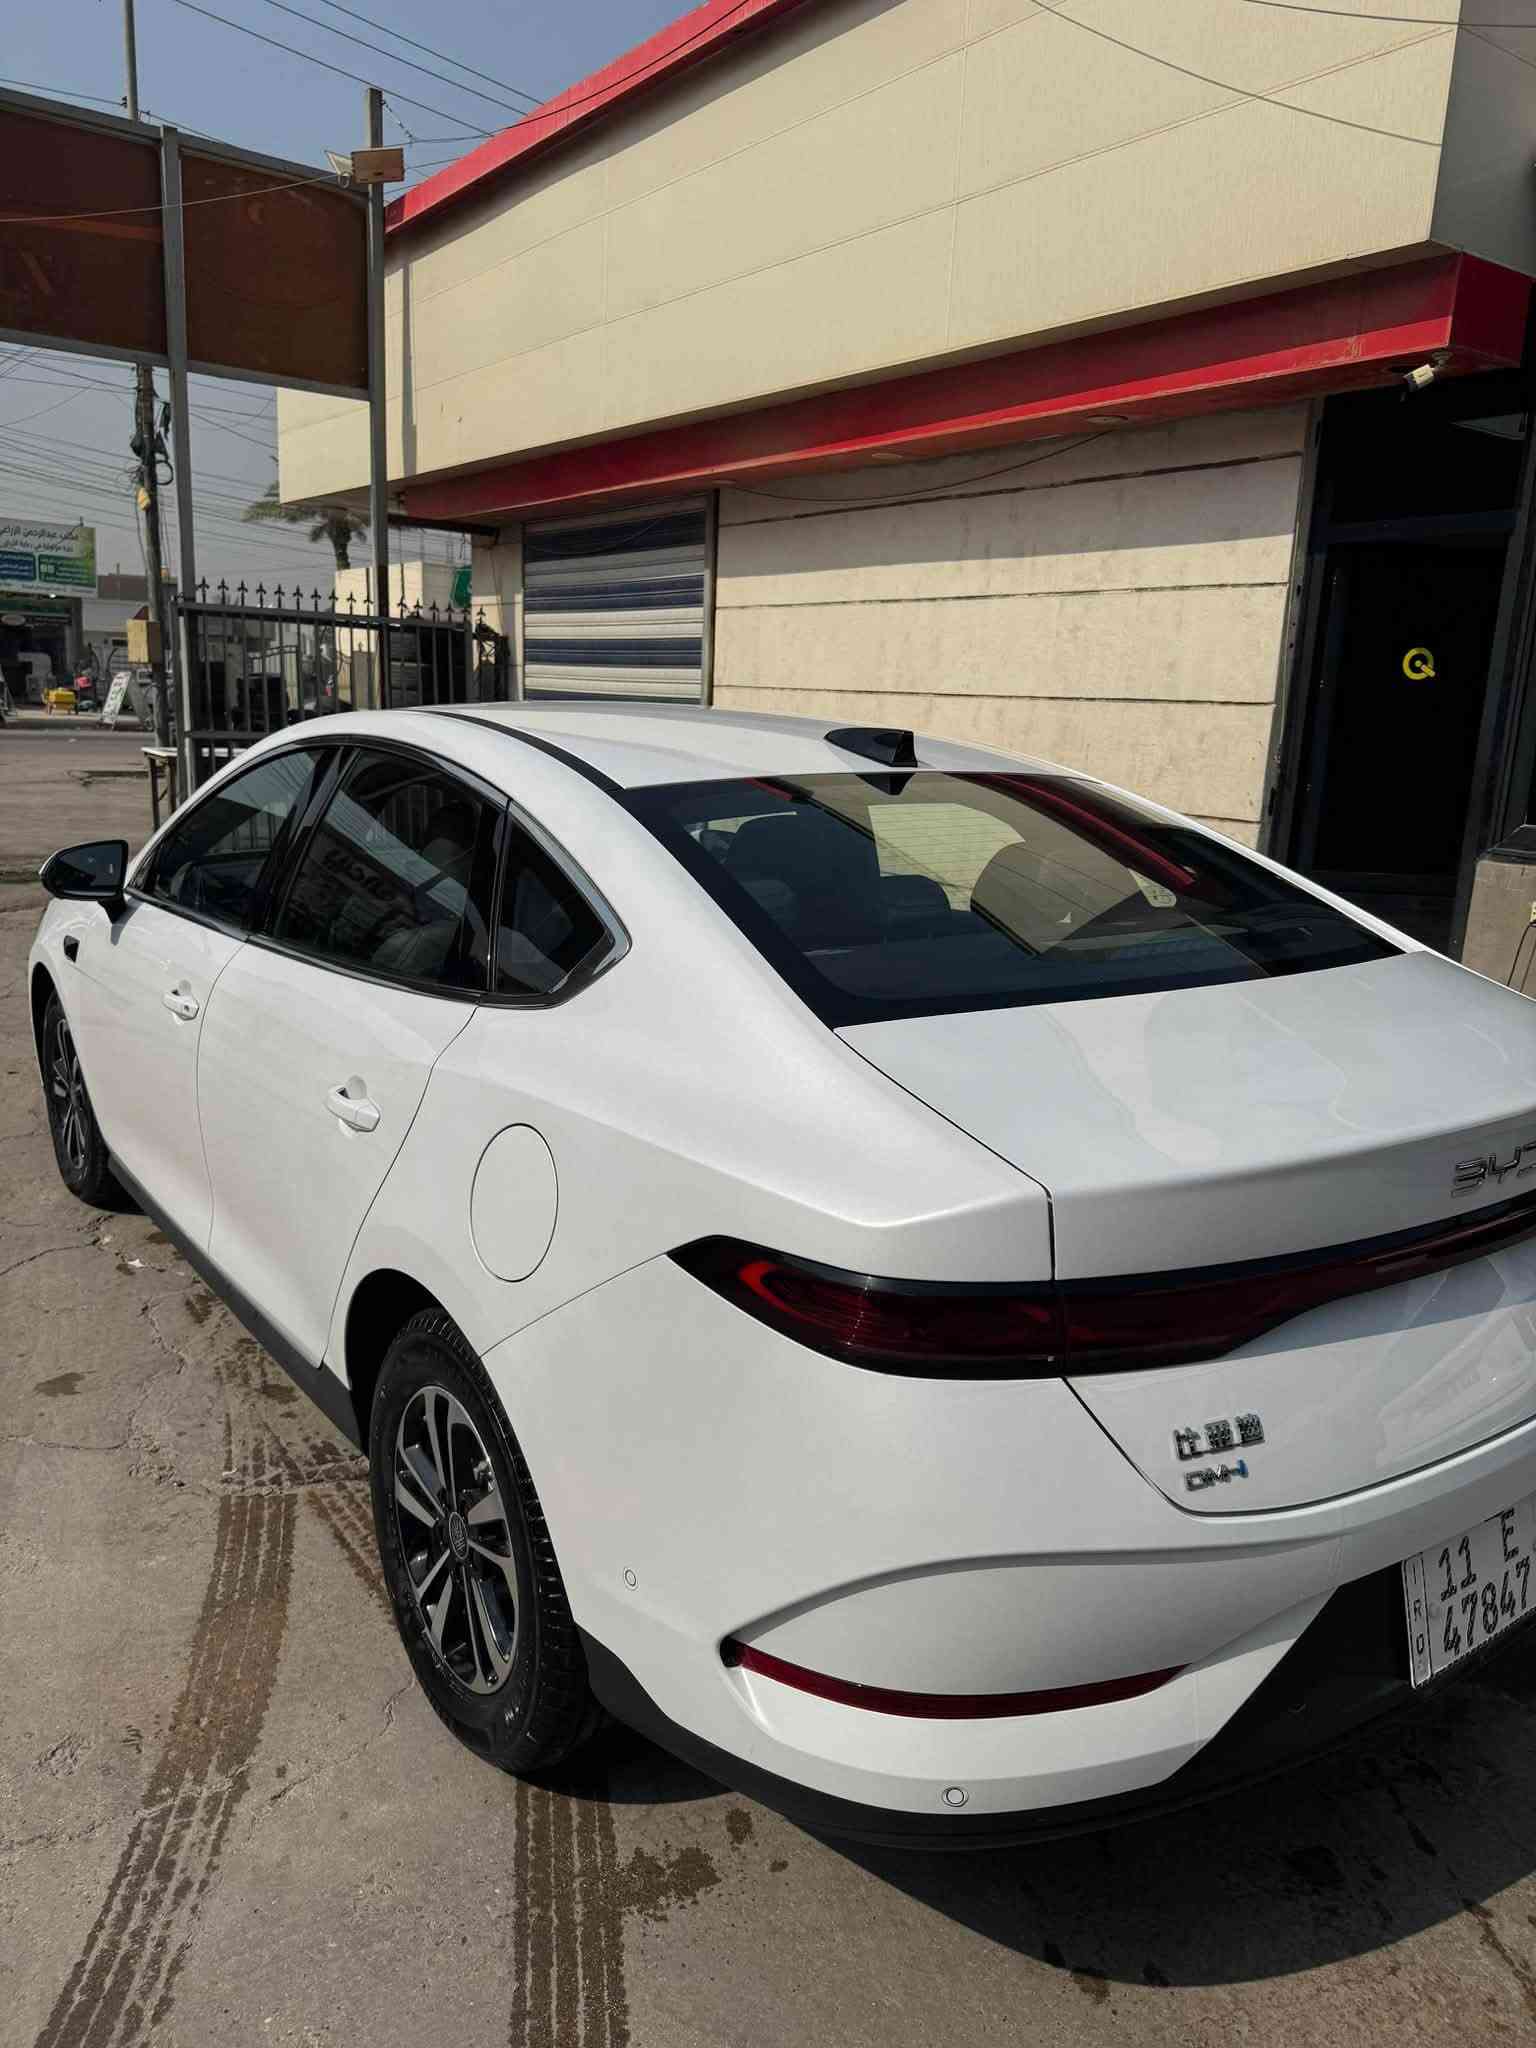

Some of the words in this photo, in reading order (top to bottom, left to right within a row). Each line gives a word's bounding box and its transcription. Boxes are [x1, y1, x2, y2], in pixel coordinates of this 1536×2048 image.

[1438, 1535, 1477, 1602] 11
[1500, 1507, 1519, 1563] E
[1443, 1555, 1531, 1656] 47847
